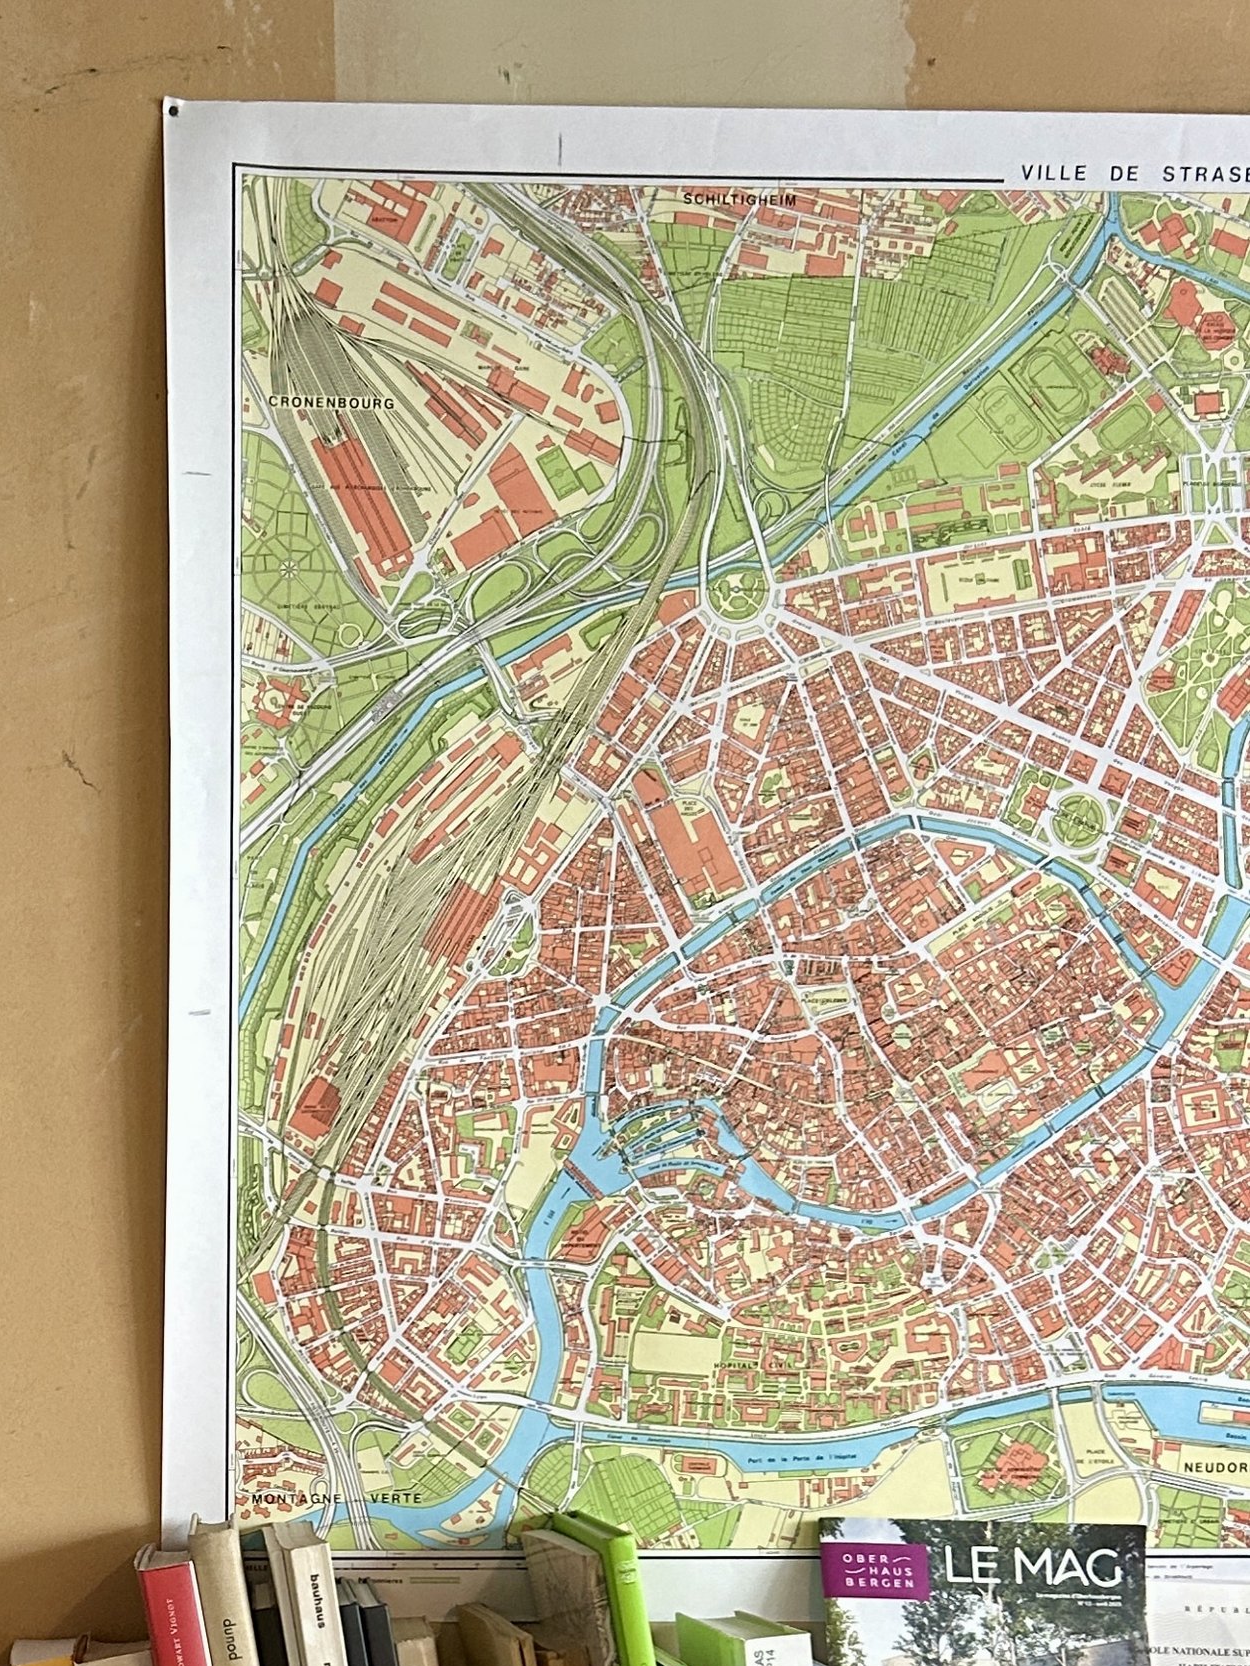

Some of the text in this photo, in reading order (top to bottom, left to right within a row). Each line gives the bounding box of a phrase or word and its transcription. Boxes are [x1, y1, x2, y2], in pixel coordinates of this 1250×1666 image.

[1021, 164, 1087, 181] VILLE
[1110, 165, 1139, 182] DE
[682, 193, 797, 206] SCHILTIGHEIM
[268, 395, 395, 411] CRONENBOURG
[251, 1493, 422, 1505] MONTAGNE VERTE
[842, 1553, 888, 1564] OBER
[869, 1566, 913, 1577] HAUS
[944, 1544, 1123, 1589] LE MAG
[845, 1577, 915, 1589] BERGEN
[309, 1573, 325, 1629] bauhaus
[223, 1618, 243, 1661] dunod
[1148, 1646, 1170, 1655] OLE
[1171, 1646, 1231, 1657] NATIONALE
